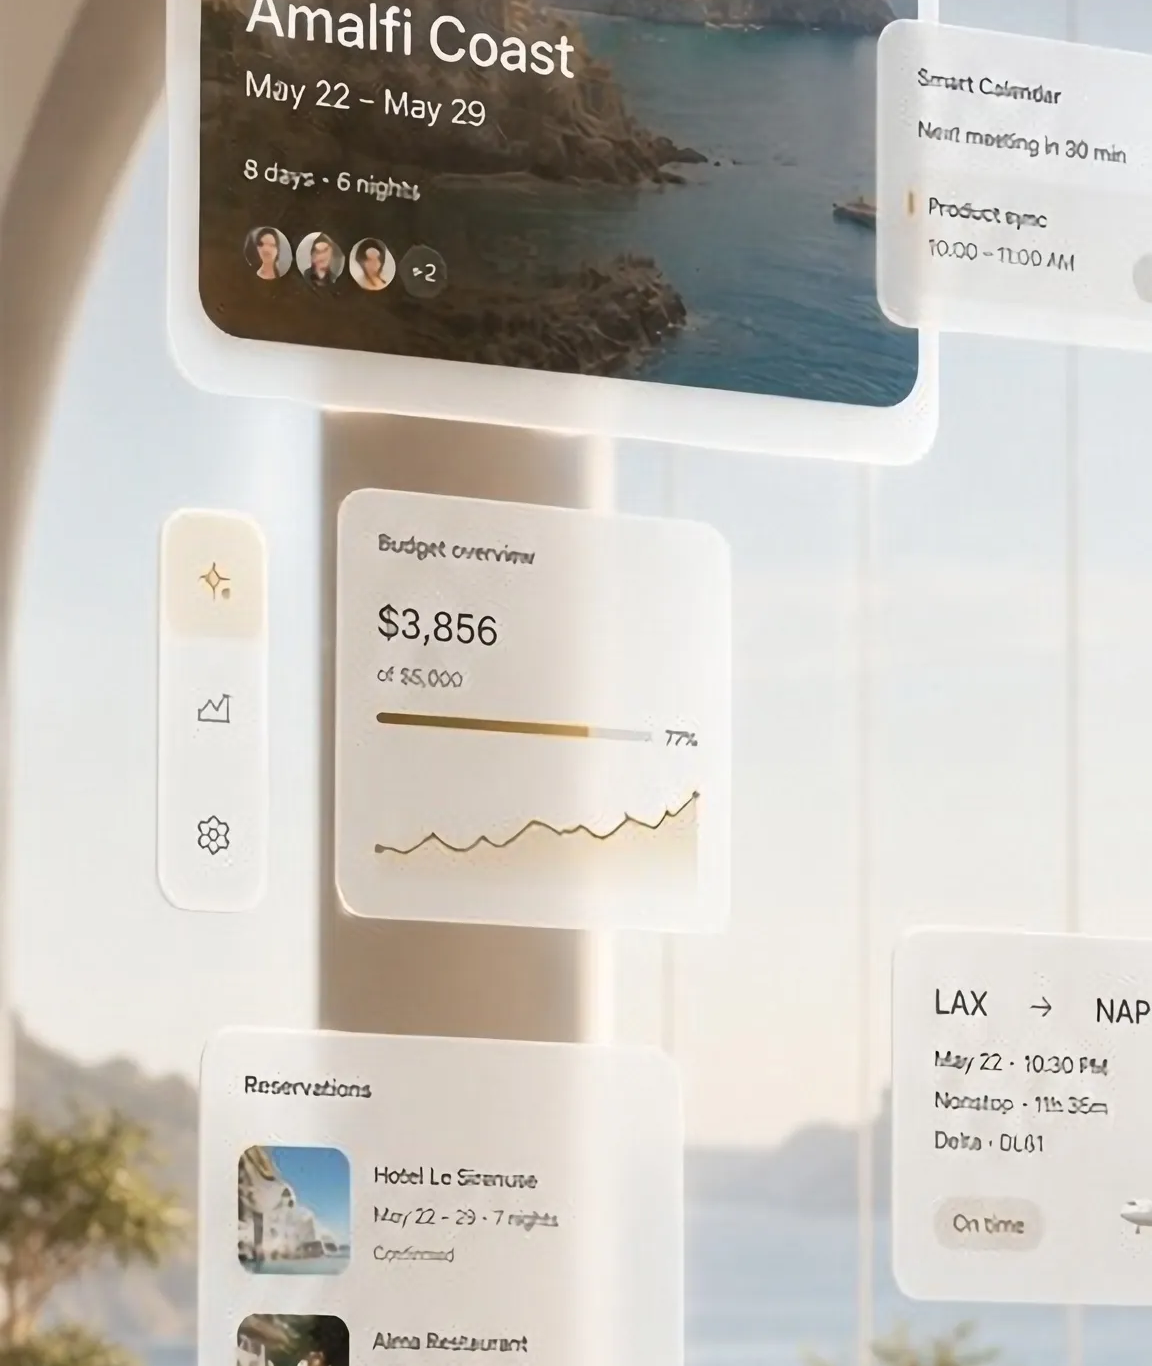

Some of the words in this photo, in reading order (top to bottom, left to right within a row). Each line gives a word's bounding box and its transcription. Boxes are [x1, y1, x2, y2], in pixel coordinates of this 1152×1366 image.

[430, 16, 574, 78] Coast
[246, 70, 306, 110] May
[316, 80, 350, 109] 22
[385, 89, 442, 127] May
[452, 99, 485, 126] 29
[1066, 140, 1088, 159] 30
[1094, 144, 1126, 163] min
[244, 159, 258, 179] 8
[337, 172, 350, 191] 6
[378, 604, 497, 646] $3,856
[377, 666, 394, 682] of
[936, 988, 987, 1016] LAX
[1097, 998, 1150, 1024] NAP
[980, 1053, 1002, 1071] 22
[415, 1208, 435, 1224] 22
[493, 1210, 504, 1225] 7
[953, 1214, 979, 1233] On
